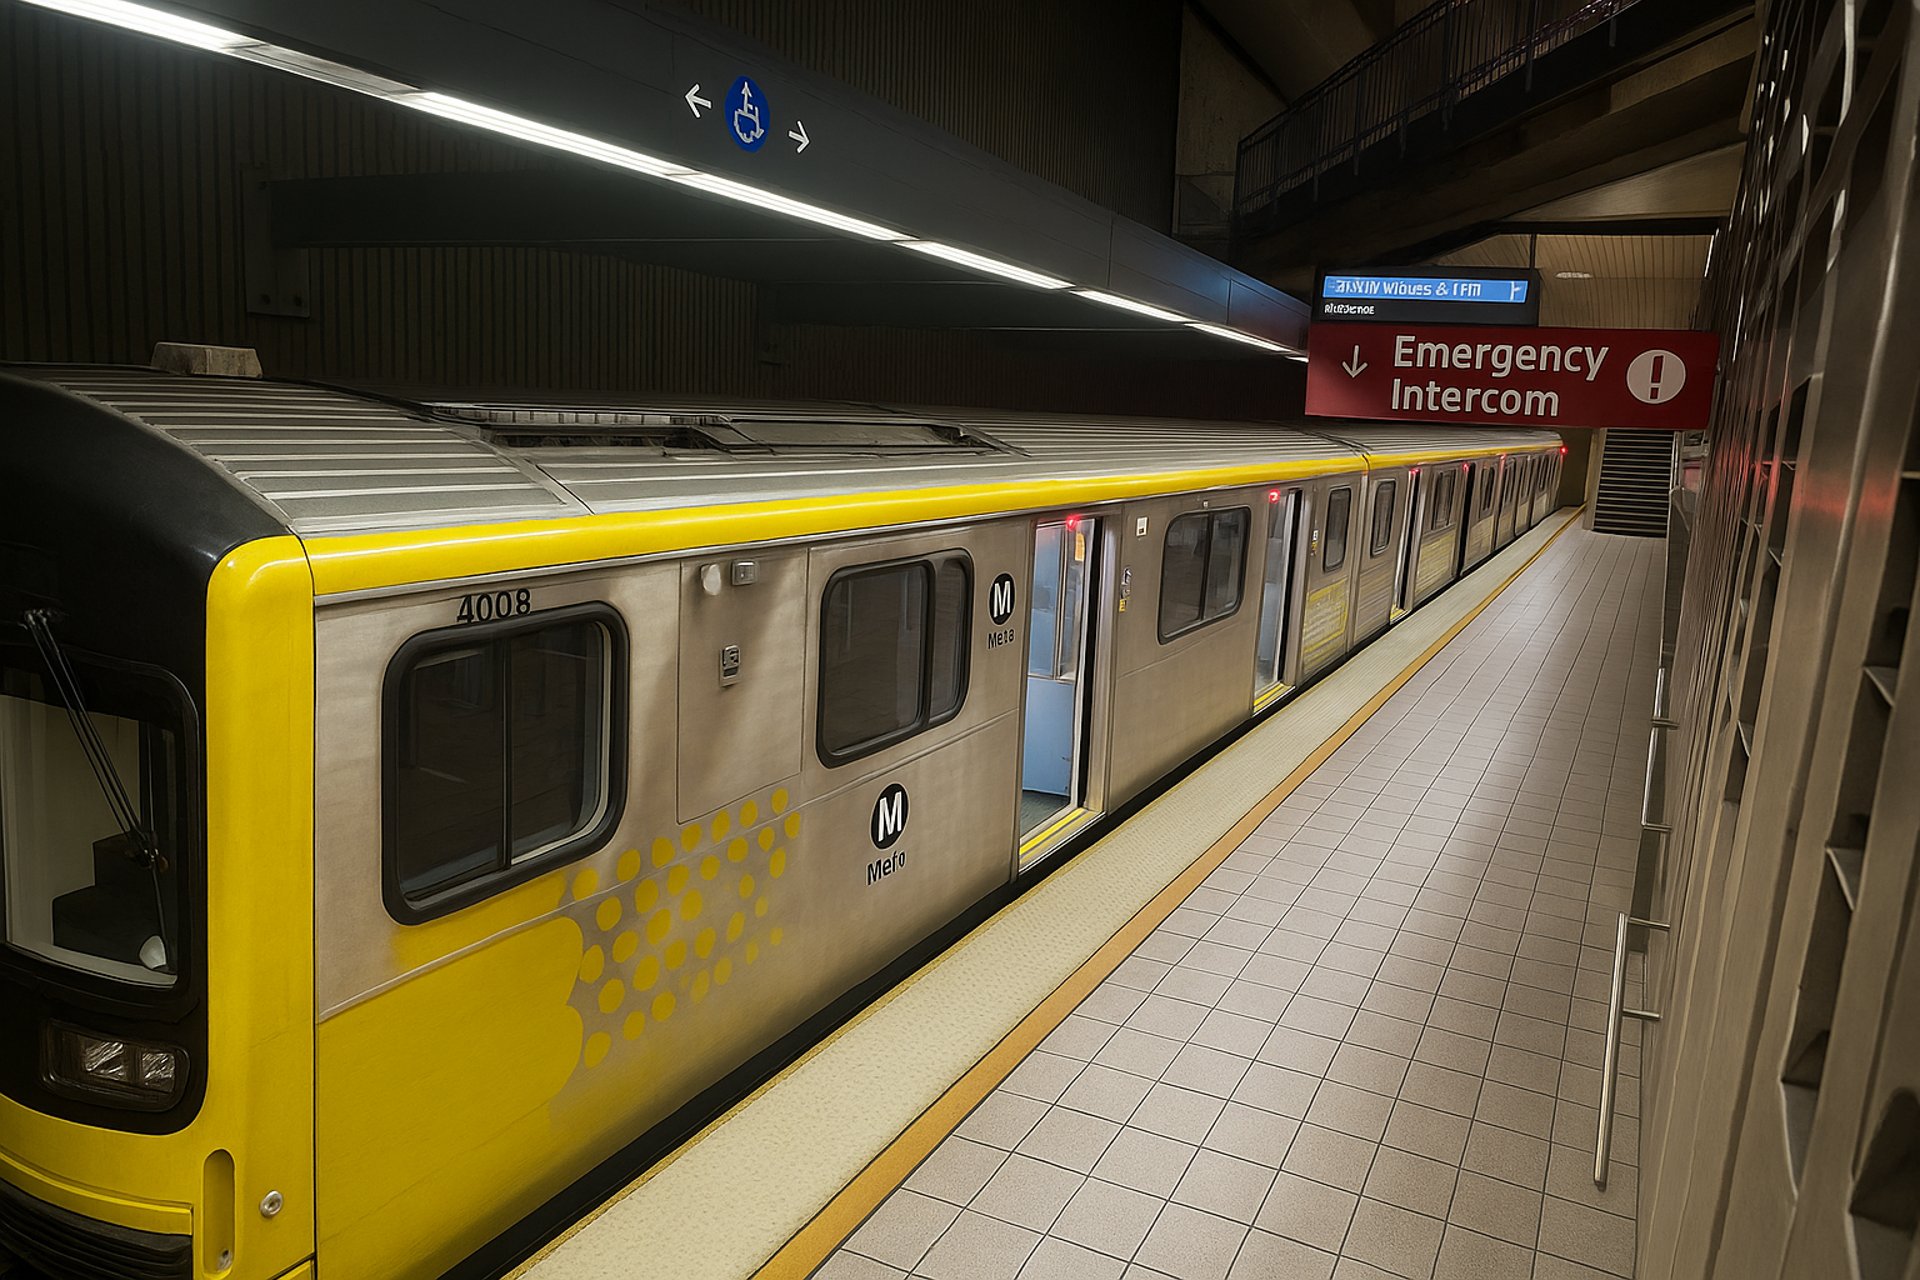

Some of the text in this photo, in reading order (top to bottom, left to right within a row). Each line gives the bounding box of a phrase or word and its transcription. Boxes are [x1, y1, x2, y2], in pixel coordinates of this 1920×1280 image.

[1394, 335, 1609, 381] Emergency
[1391, 378, 1559, 417] Intercom
[456, 588, 531, 624] 4008
